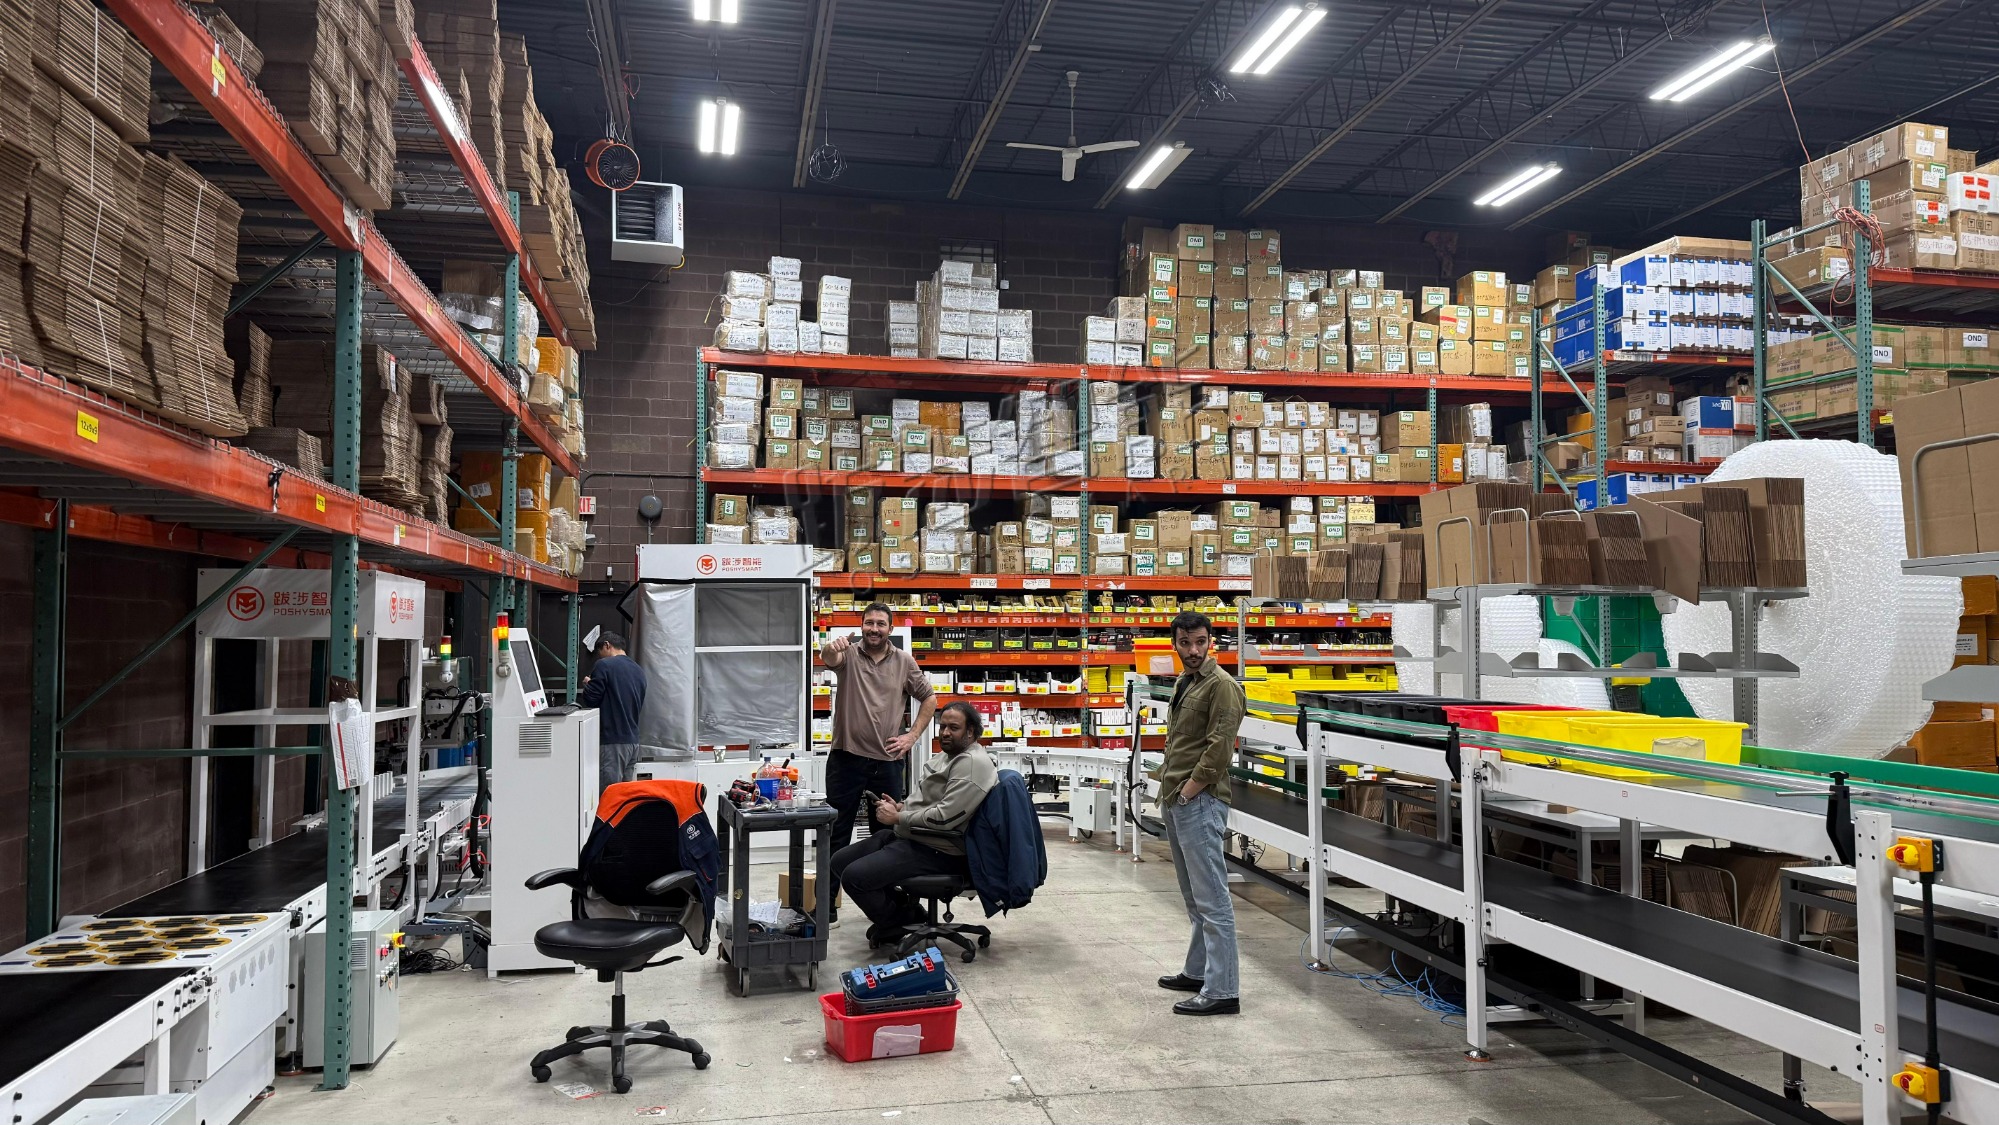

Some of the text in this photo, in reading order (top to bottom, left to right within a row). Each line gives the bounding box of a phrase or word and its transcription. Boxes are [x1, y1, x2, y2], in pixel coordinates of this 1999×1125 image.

[81, 420, 97, 435] 12x9x9
[579, 497, 591, 512] XIT
[273, 591, 331, 606] 跋涉智
[273, 608, 331, 616] POSHYSMA
